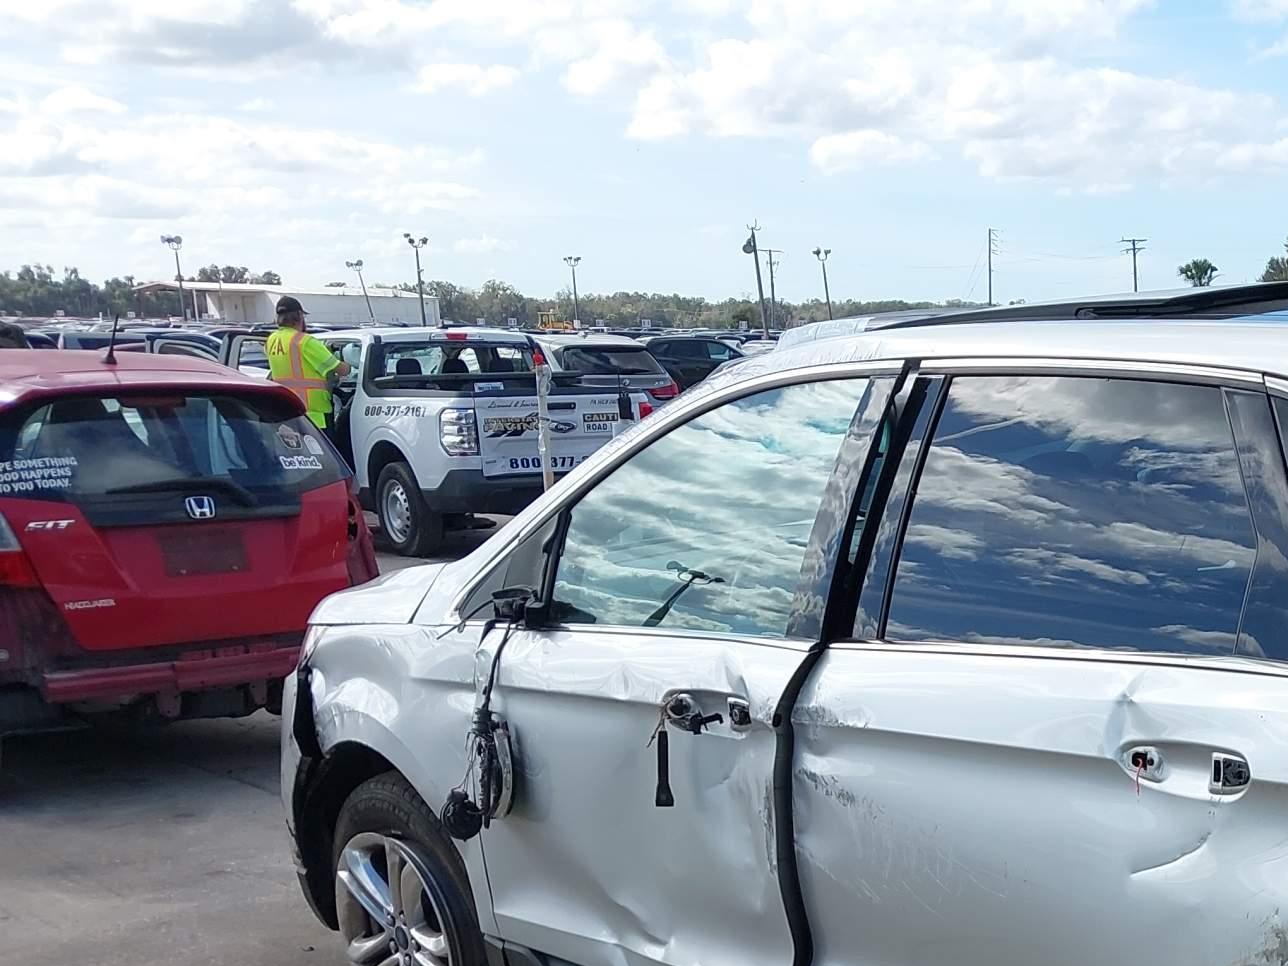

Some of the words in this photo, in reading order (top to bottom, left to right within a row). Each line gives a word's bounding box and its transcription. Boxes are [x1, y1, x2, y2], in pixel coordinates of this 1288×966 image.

[586, 423, 607, 431] ROAD
[14, 457, 78, 469] SOMETHING
[21, 467, 72, 479] HAPPENS
[12, 481, 34, 493] YOU
[35, 478, 72, 489] TODAY.
